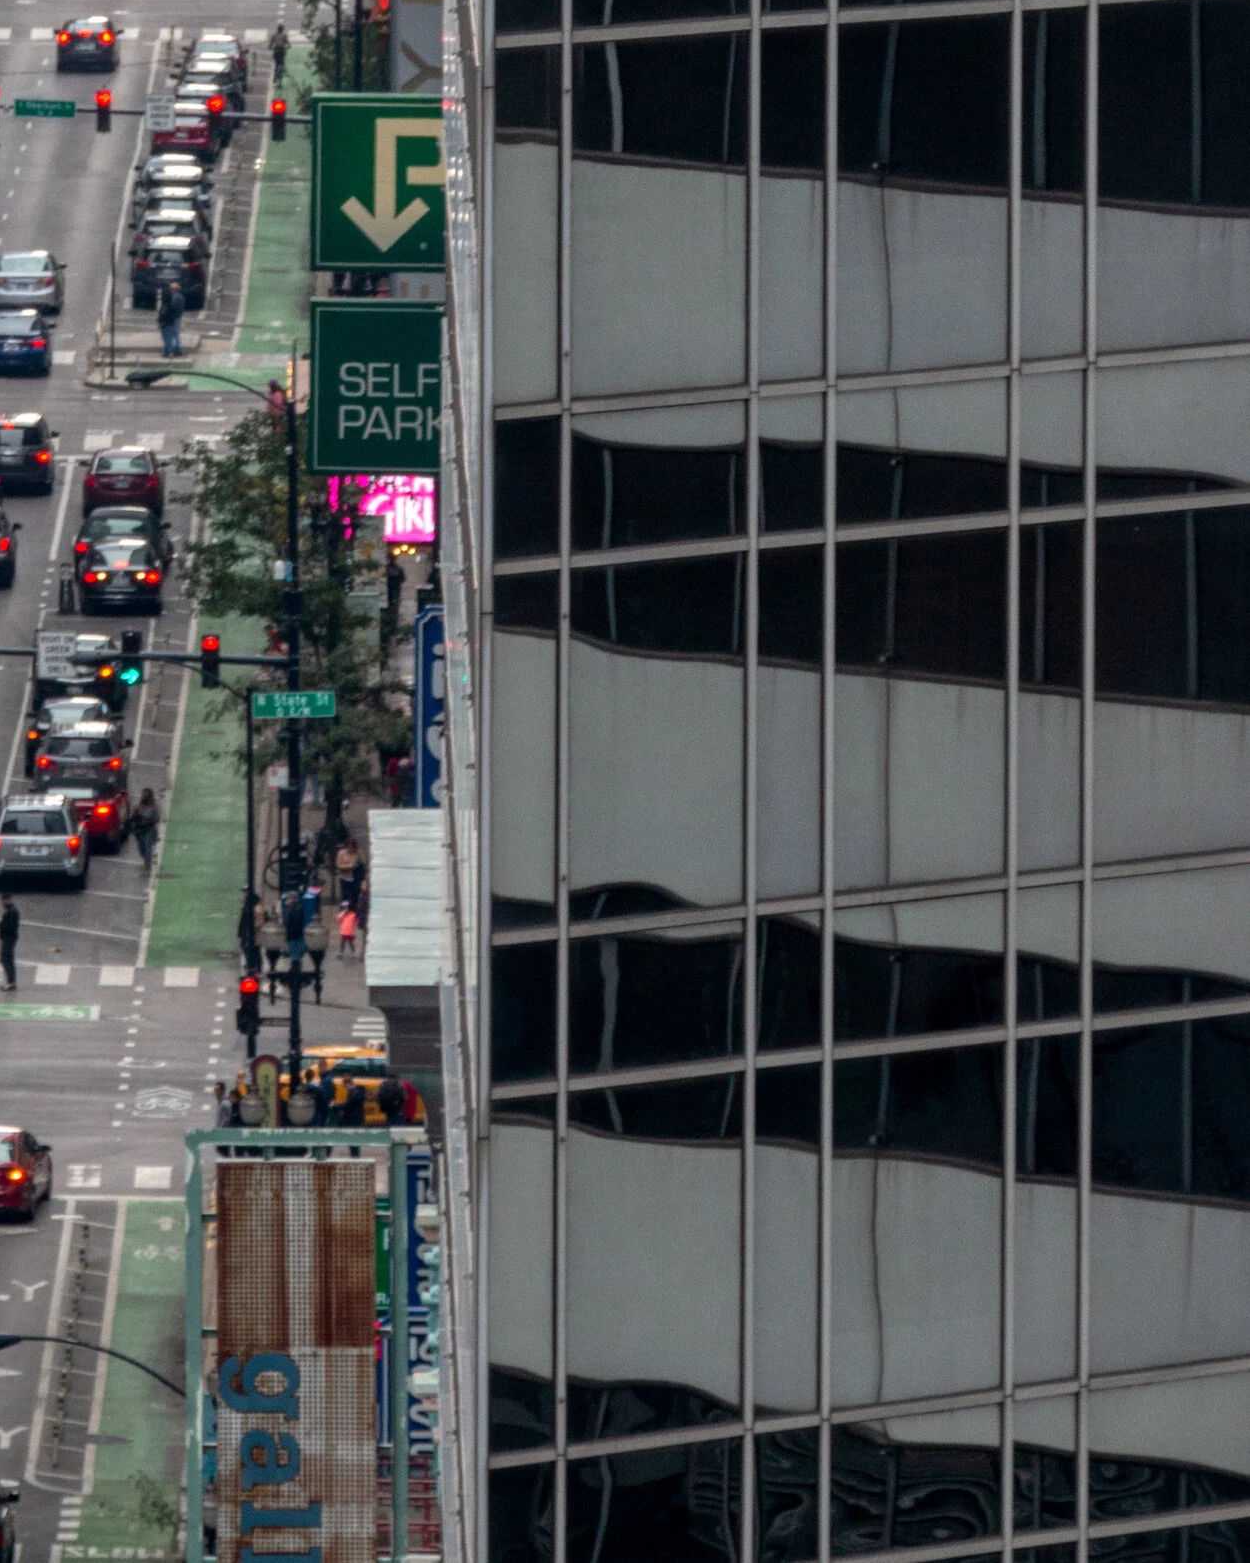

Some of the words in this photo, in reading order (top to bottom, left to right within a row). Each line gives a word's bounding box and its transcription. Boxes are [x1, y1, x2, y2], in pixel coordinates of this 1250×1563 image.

[339, 362, 440, 398] SELF
[338, 405, 443, 441] PARK
[273, 693, 308, 707] State
